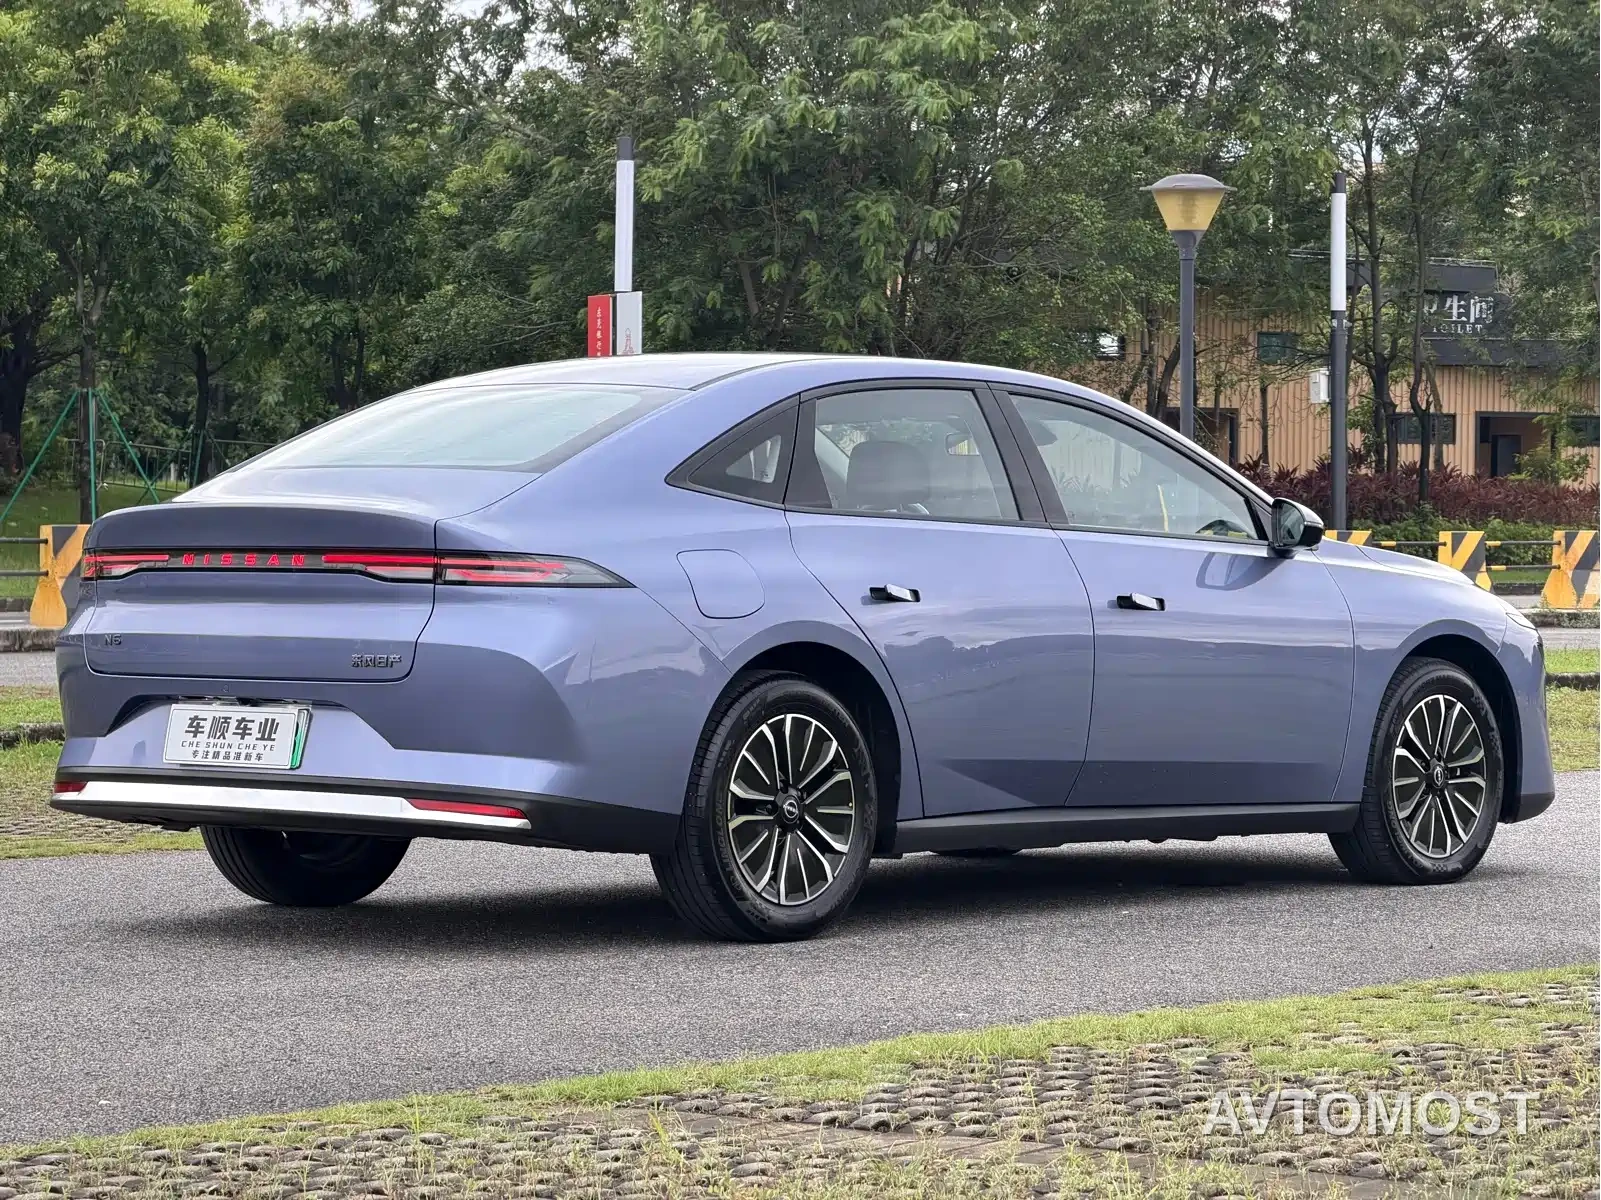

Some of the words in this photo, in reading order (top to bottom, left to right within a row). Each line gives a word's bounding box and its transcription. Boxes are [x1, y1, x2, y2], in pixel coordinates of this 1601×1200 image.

[182, 553, 306, 566] NISSAN
[351, 653, 402, 668] 东风日产
[185, 715, 280, 741] 车顺车业
[181, 740, 201, 749] CHE
[205, 741, 233, 750] SHUN
[263, 744, 276, 752] YE
[192, 750, 264, 761] 专注精品准新车
